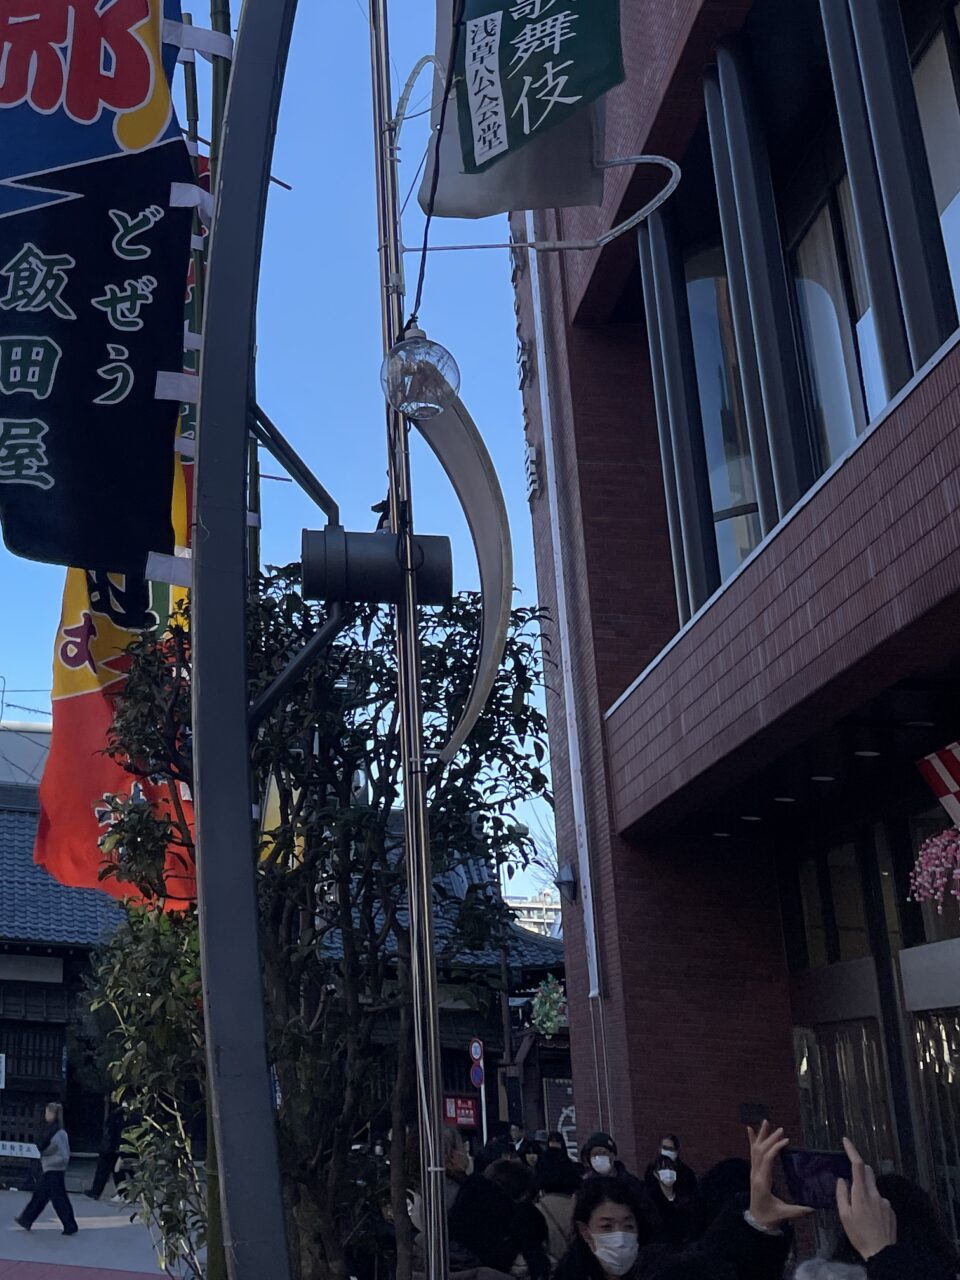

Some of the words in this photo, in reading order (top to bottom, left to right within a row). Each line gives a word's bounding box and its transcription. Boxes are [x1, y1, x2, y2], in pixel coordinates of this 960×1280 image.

[469, 17, 504, 153] 浅草公会堂
[92, 204, 166, 406] どぜう
